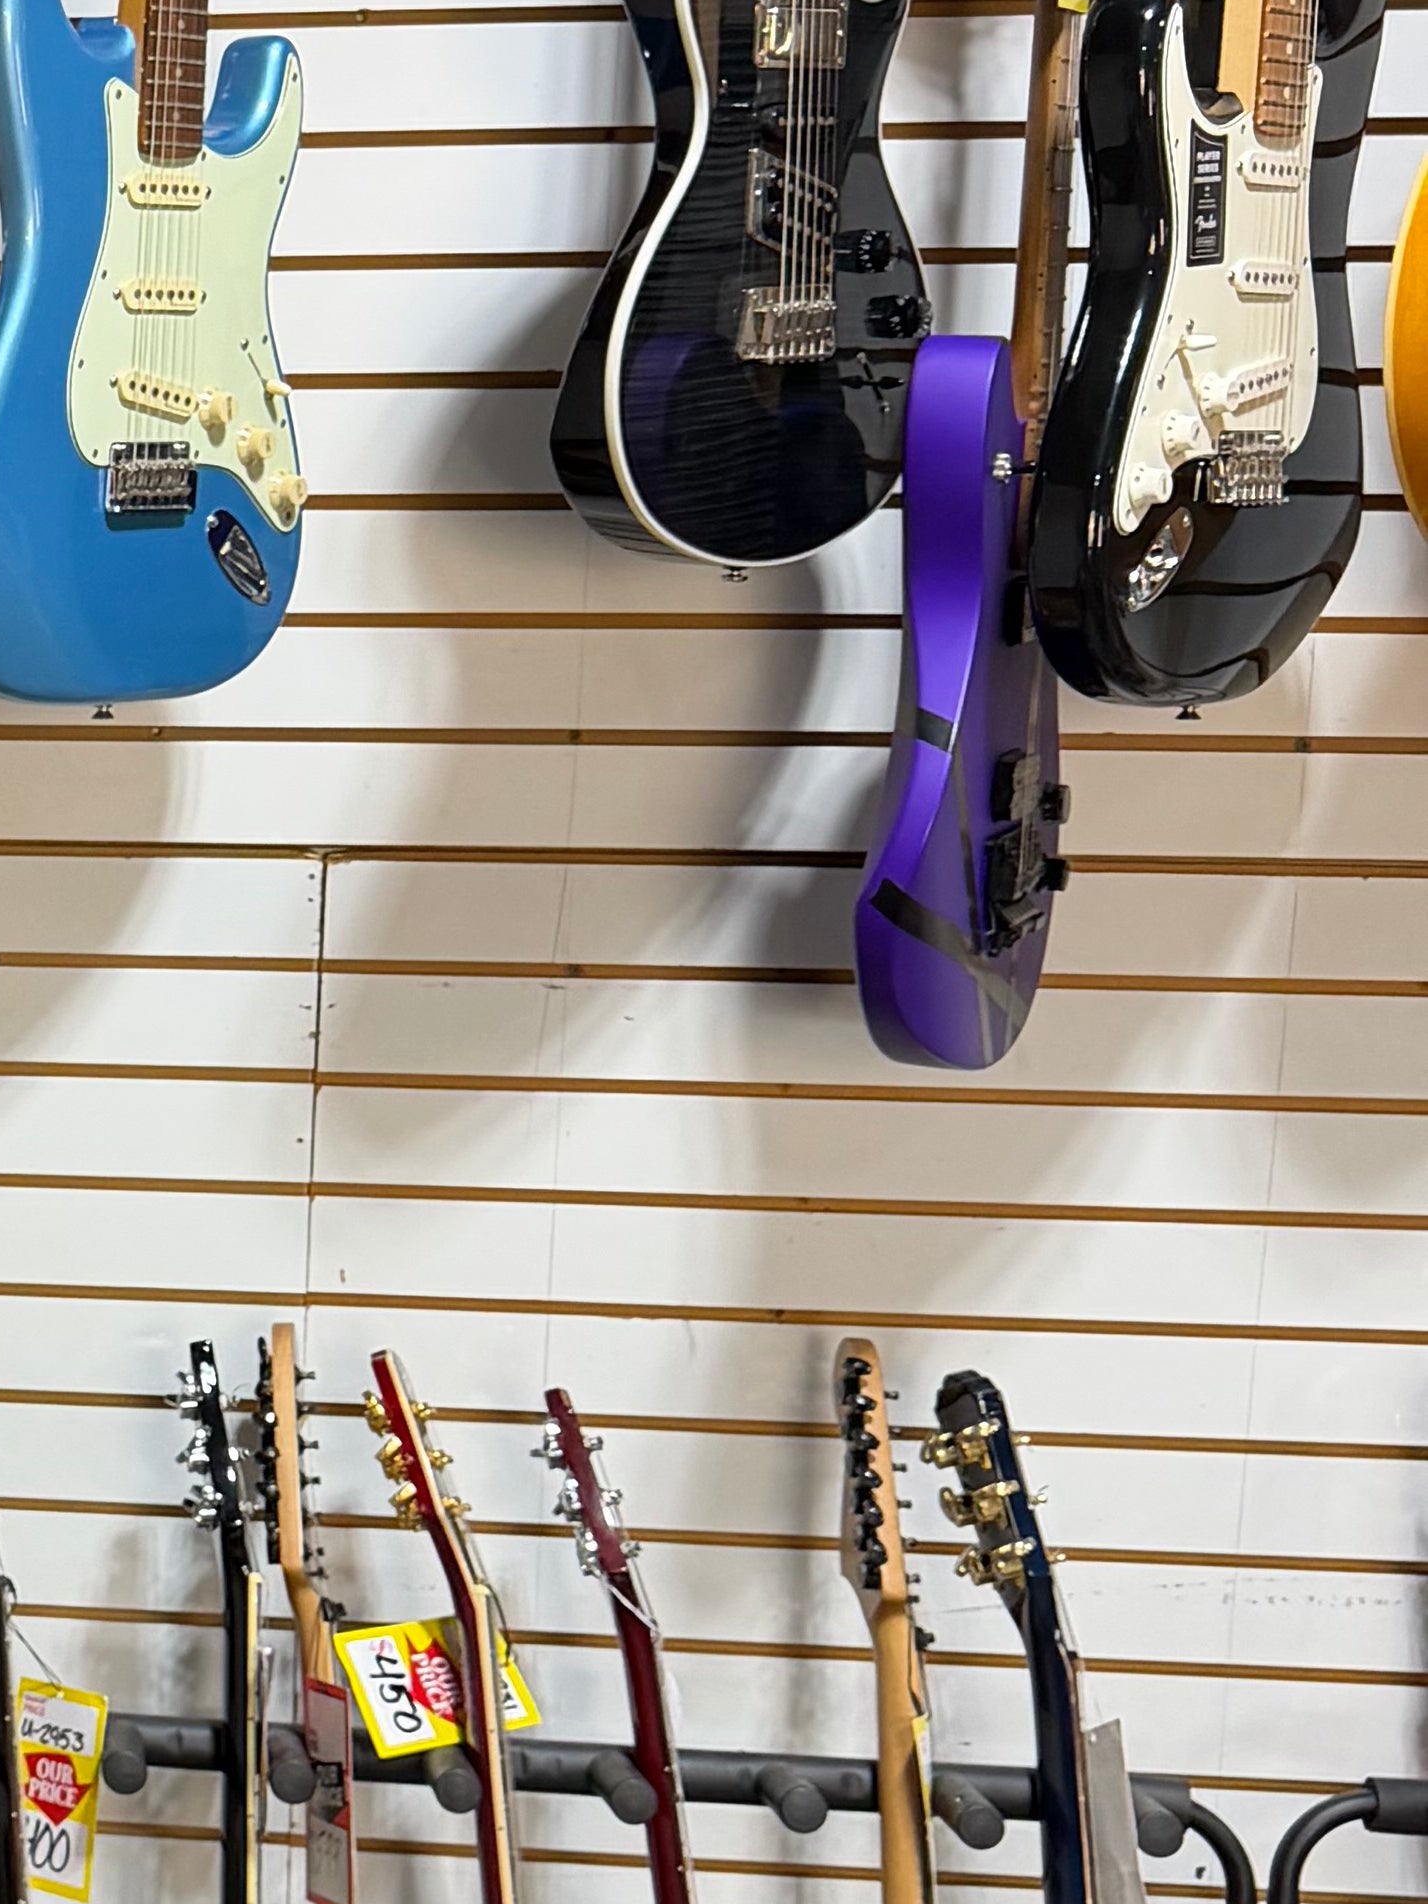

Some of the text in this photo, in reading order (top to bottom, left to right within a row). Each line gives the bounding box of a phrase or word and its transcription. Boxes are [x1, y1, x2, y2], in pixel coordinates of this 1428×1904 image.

[21, 1717, 85, 1753] U-2953
[35, 1757, 75, 1785] OUR
[28, 1777, 79, 1810] PRICE
